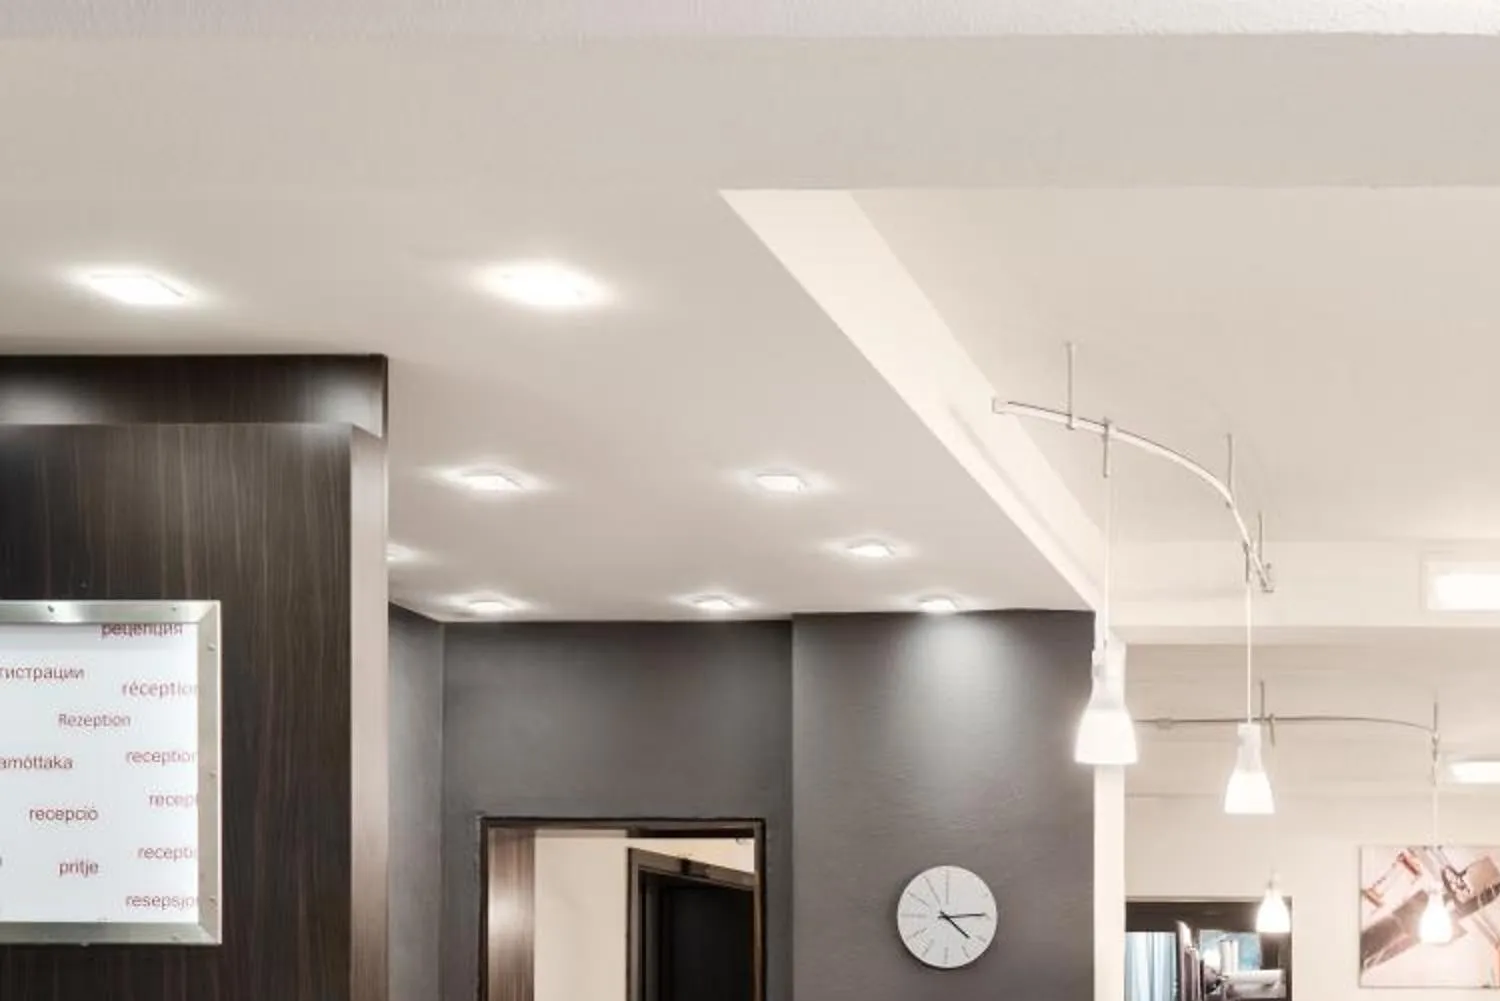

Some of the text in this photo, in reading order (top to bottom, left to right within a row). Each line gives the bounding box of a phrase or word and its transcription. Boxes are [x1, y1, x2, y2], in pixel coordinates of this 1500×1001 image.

[122, 681, 198, 699] réceptio
[58, 713, 131, 730] Rezeption
[126, 750, 197, 767] receptio
[29, 806, 99, 824] recepció
[59, 859, 99, 878] pritje
